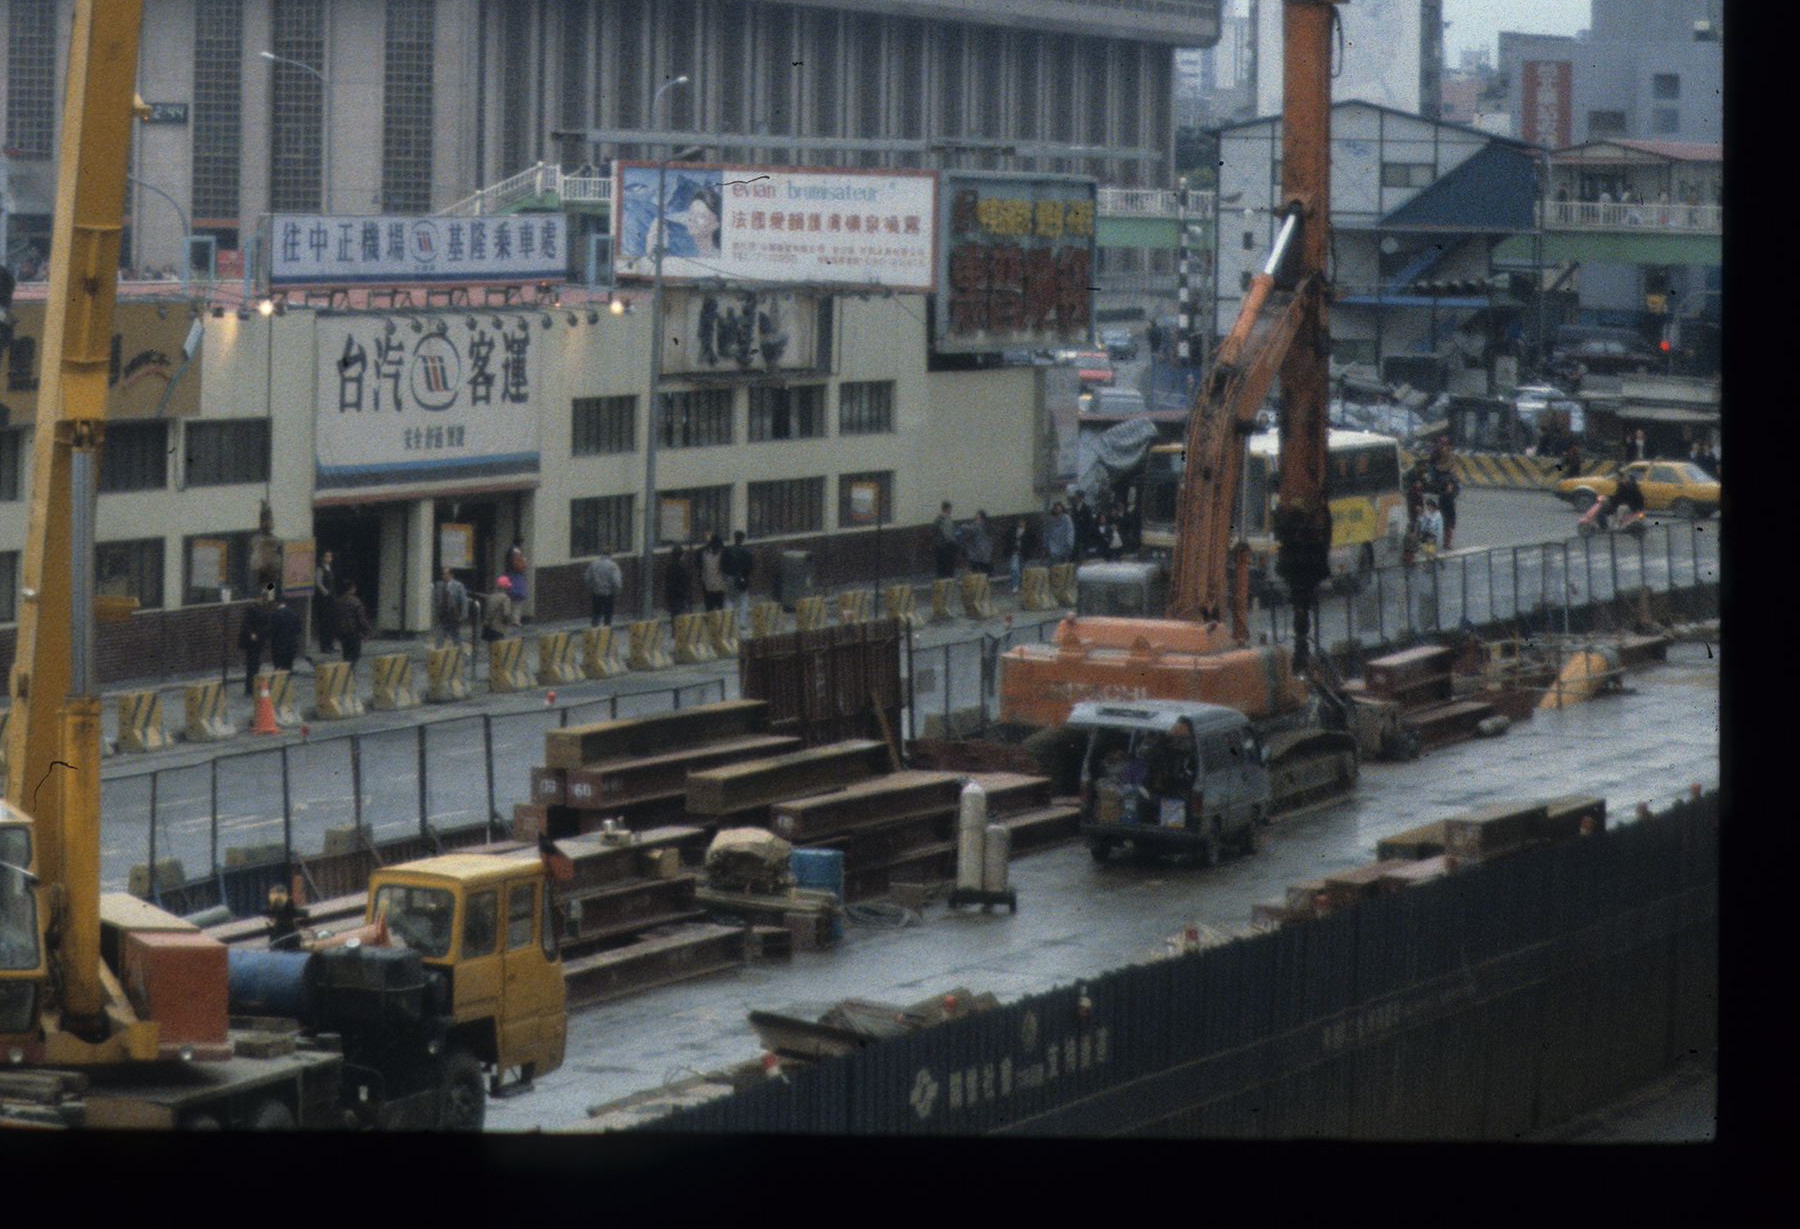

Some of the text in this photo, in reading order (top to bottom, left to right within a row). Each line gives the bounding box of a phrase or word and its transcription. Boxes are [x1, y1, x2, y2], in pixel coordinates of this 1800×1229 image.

[732, 182, 776, 198] evian
[283, 220, 557, 263] 往中正機場 基隆乘車處
[337, 329, 530, 413] 台汽 客運
